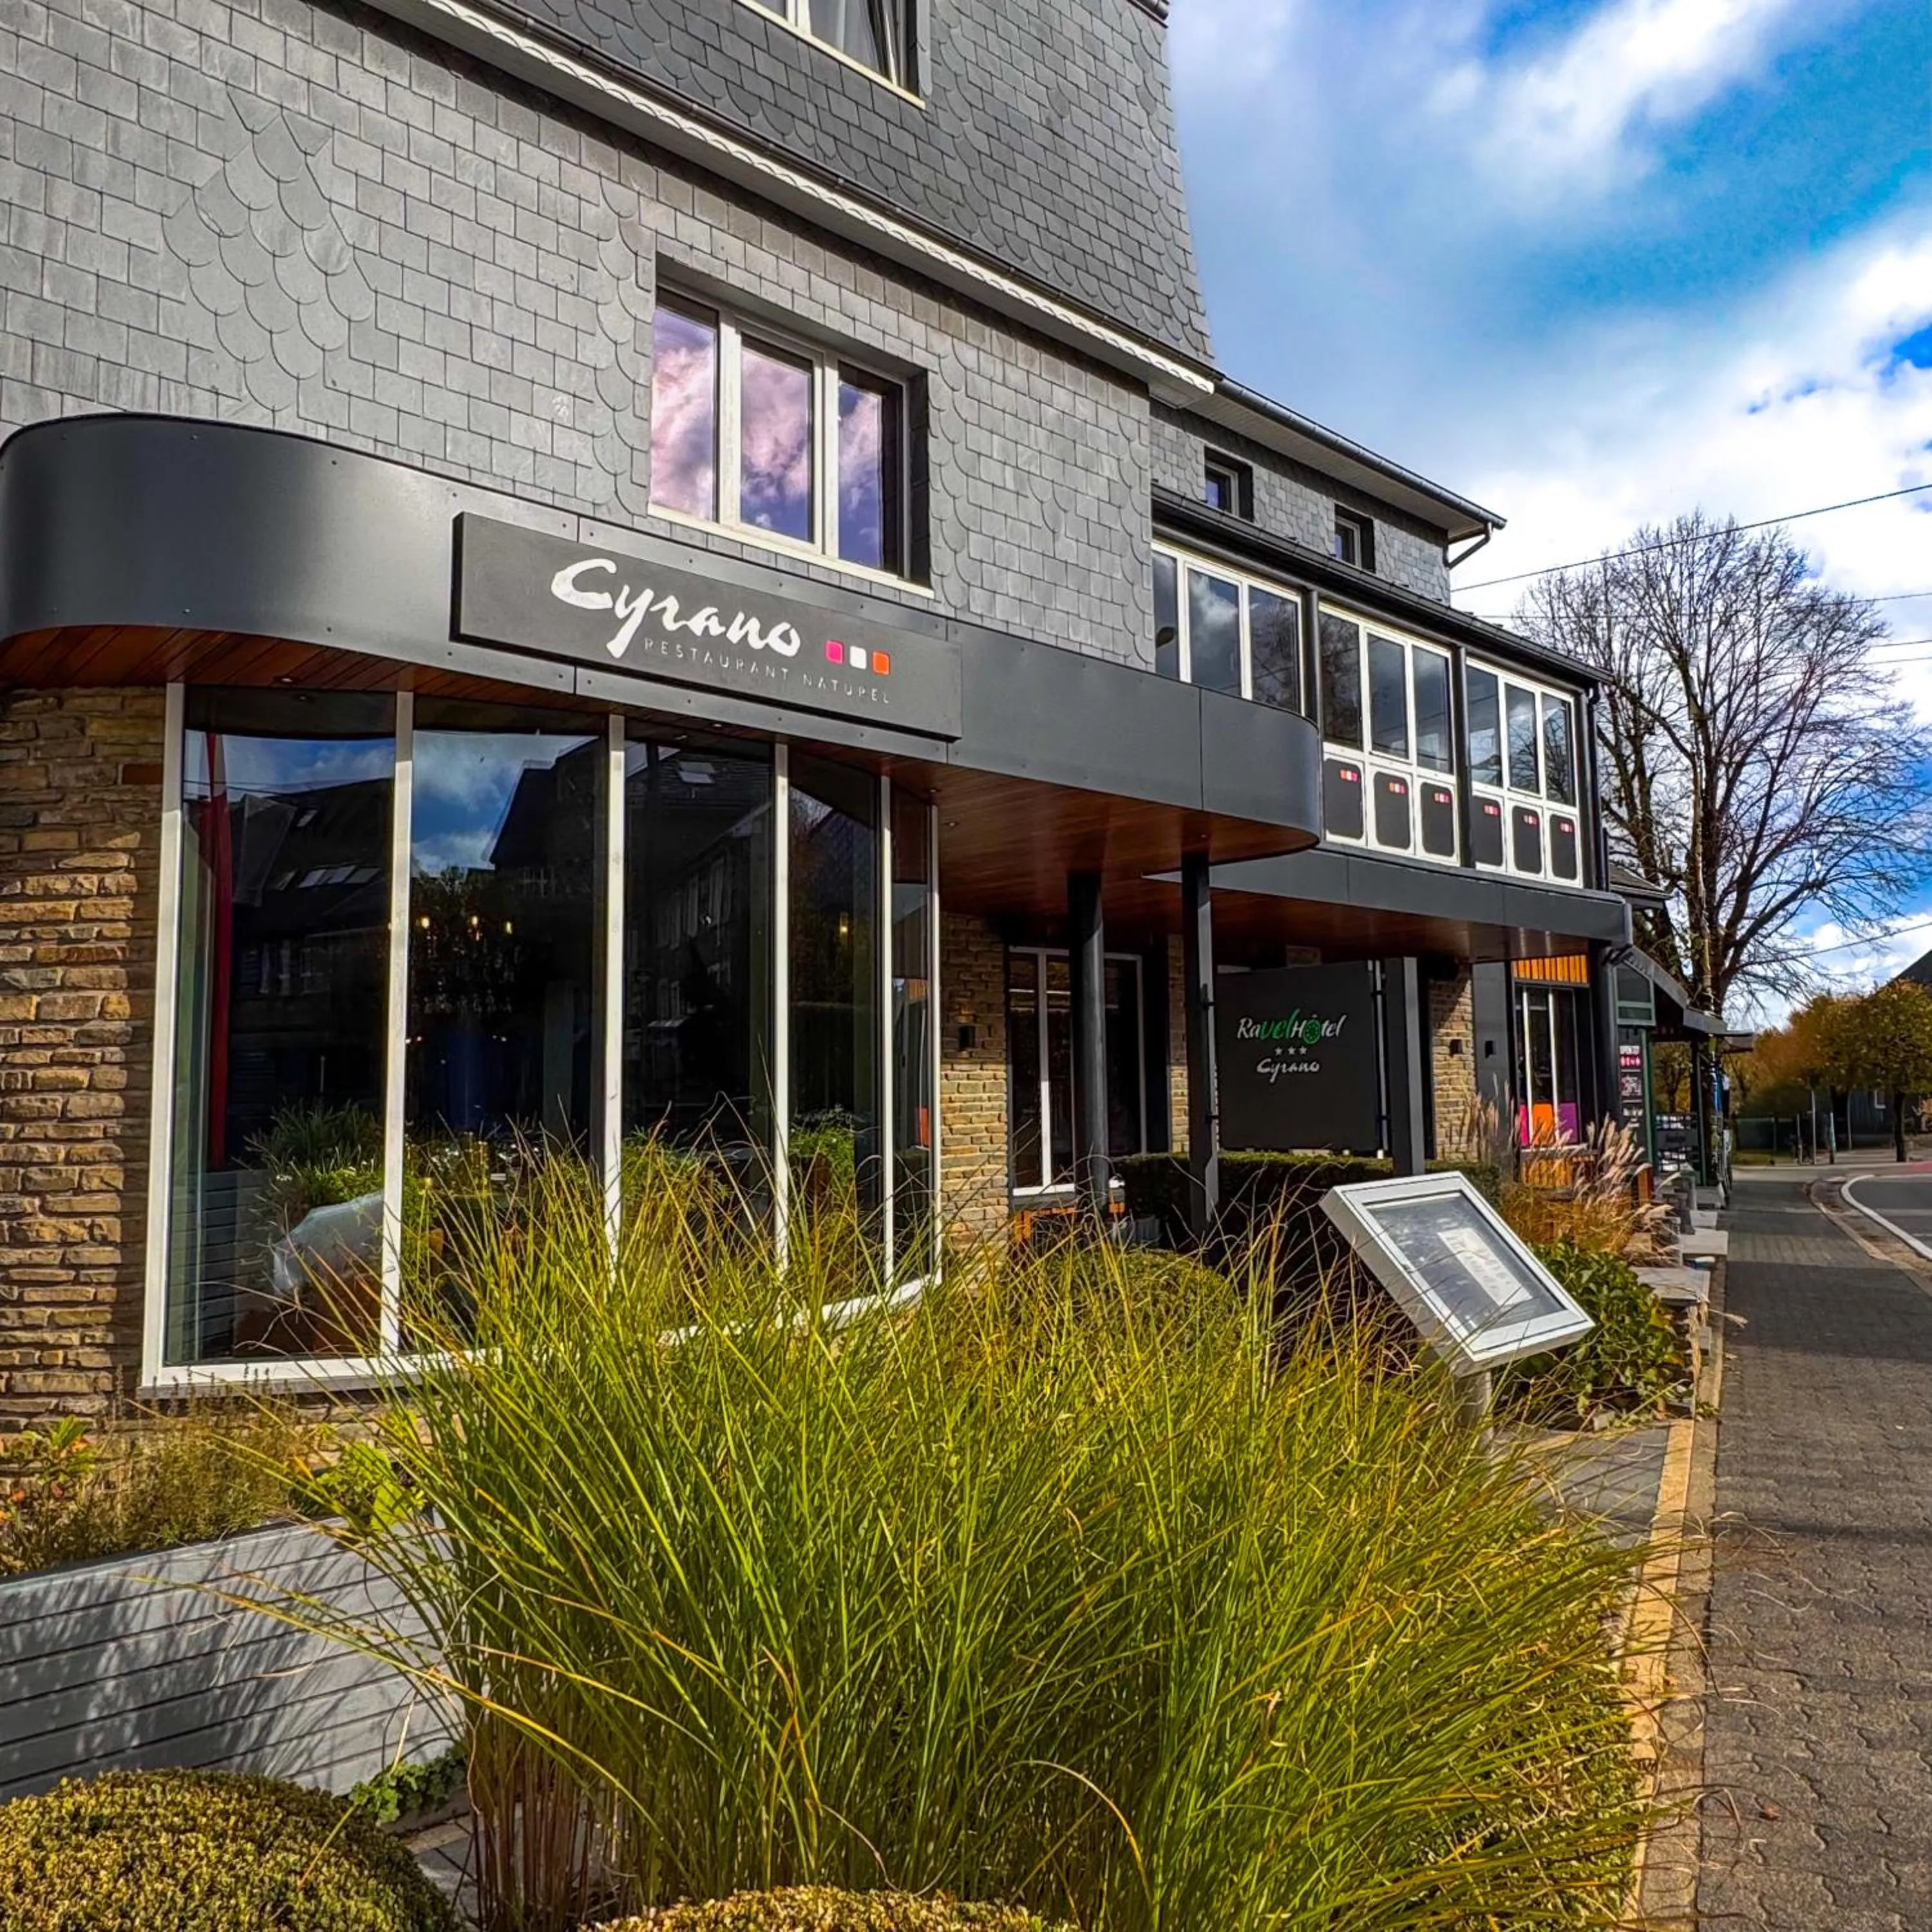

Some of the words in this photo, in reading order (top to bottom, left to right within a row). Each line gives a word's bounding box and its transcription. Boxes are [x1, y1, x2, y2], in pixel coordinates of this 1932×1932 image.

[551, 558, 800, 659] Cyrano
[644, 637, 790, 681] RESTAURANT
[1257, 1058, 1320, 1083] Cyrano
